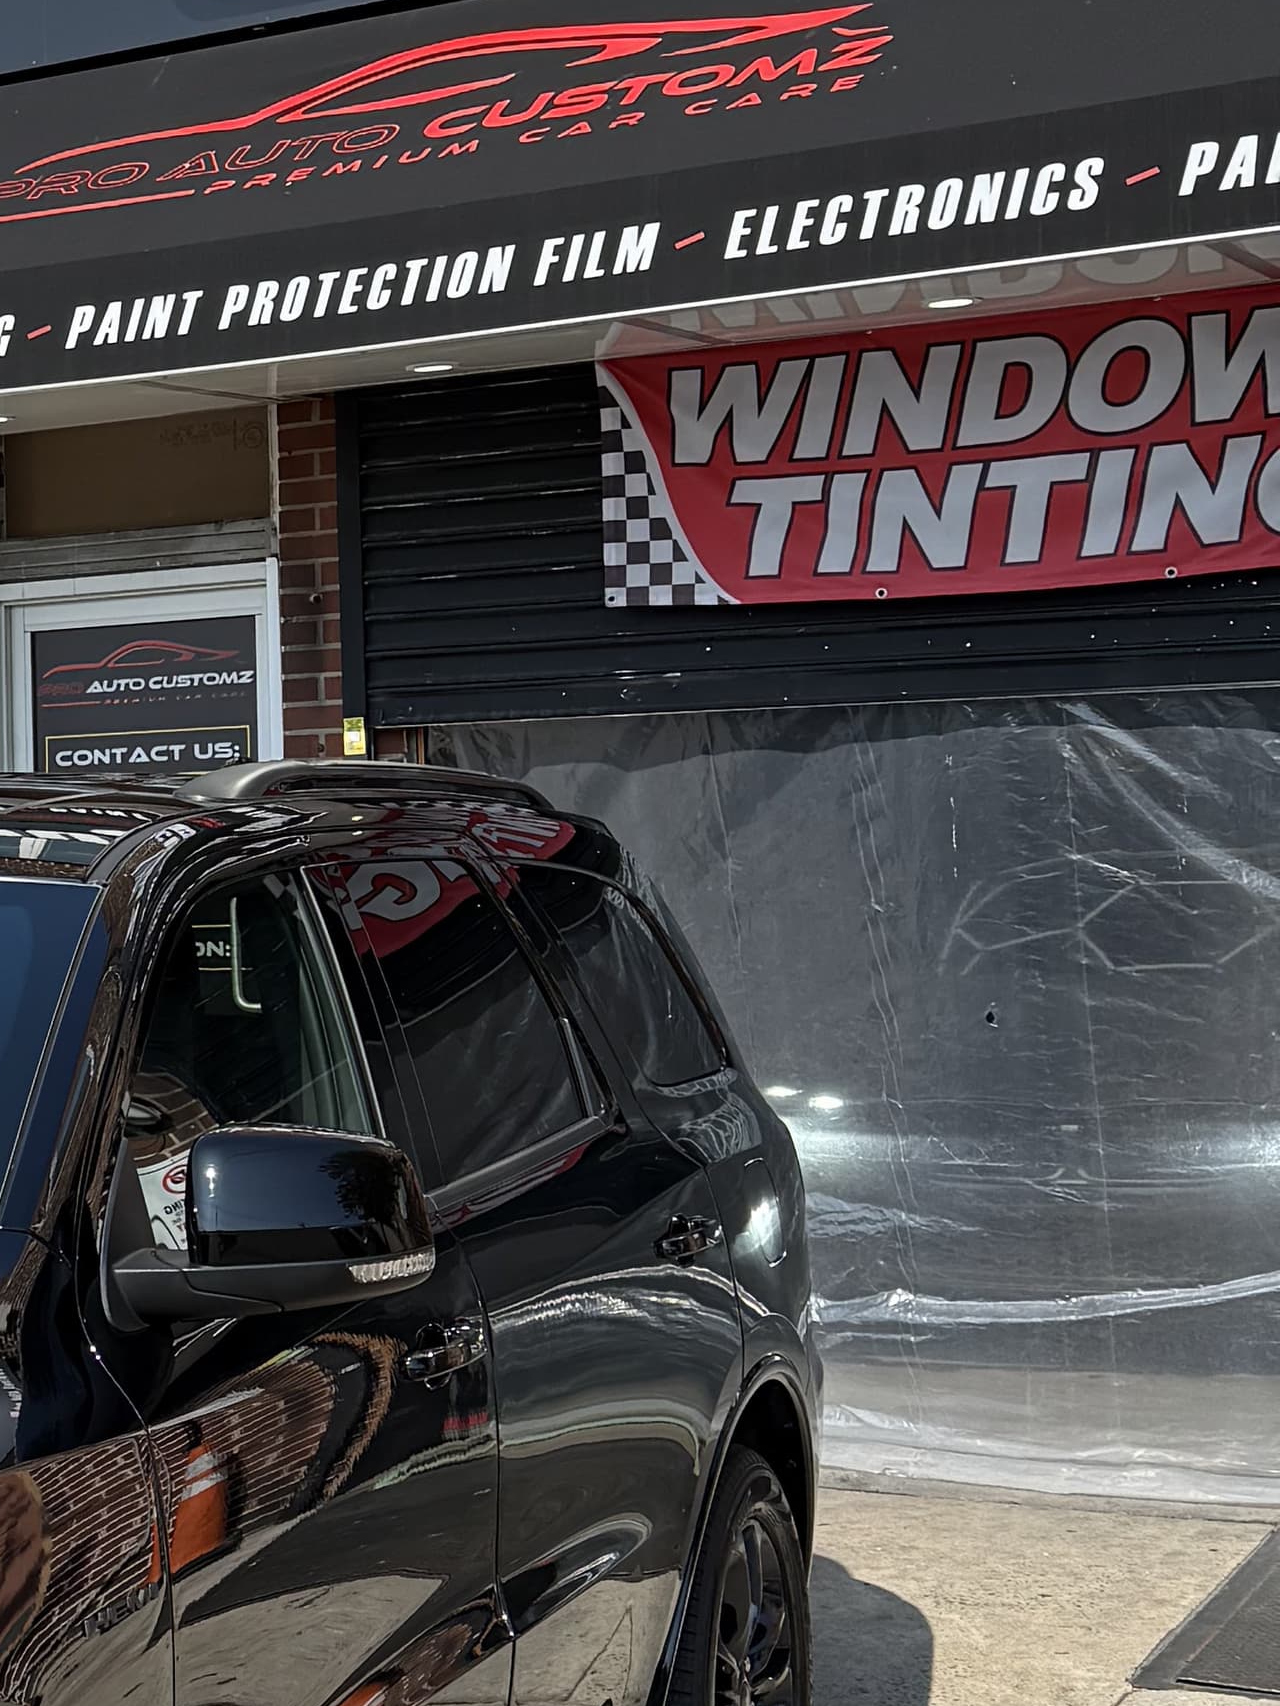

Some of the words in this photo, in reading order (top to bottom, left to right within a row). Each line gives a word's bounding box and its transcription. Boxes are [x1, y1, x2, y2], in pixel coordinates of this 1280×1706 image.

[157, 124, 400, 182] AUTO
[424, 34, 895, 140] CUSTOMZ
[204, 140, 480, 195] PREMIUM
[519, 111, 646, 145] CAR
[684, 76, 865, 116] CARE
[64, 291, 204, 350] PAINT
[219, 244, 516, 331] PROTECTION
[533, 222, 661, 287] FILM
[723, 156, 1105, 260] ELECTRONICS
[729, 434, 1280, 578] TINTIN
[86, 677, 145, 693] AUTO
[148, 670, 255, 690] CUSTOMZ
[55, 744, 186, 767] CONTACT
[194, 742, 241, 760] US:
